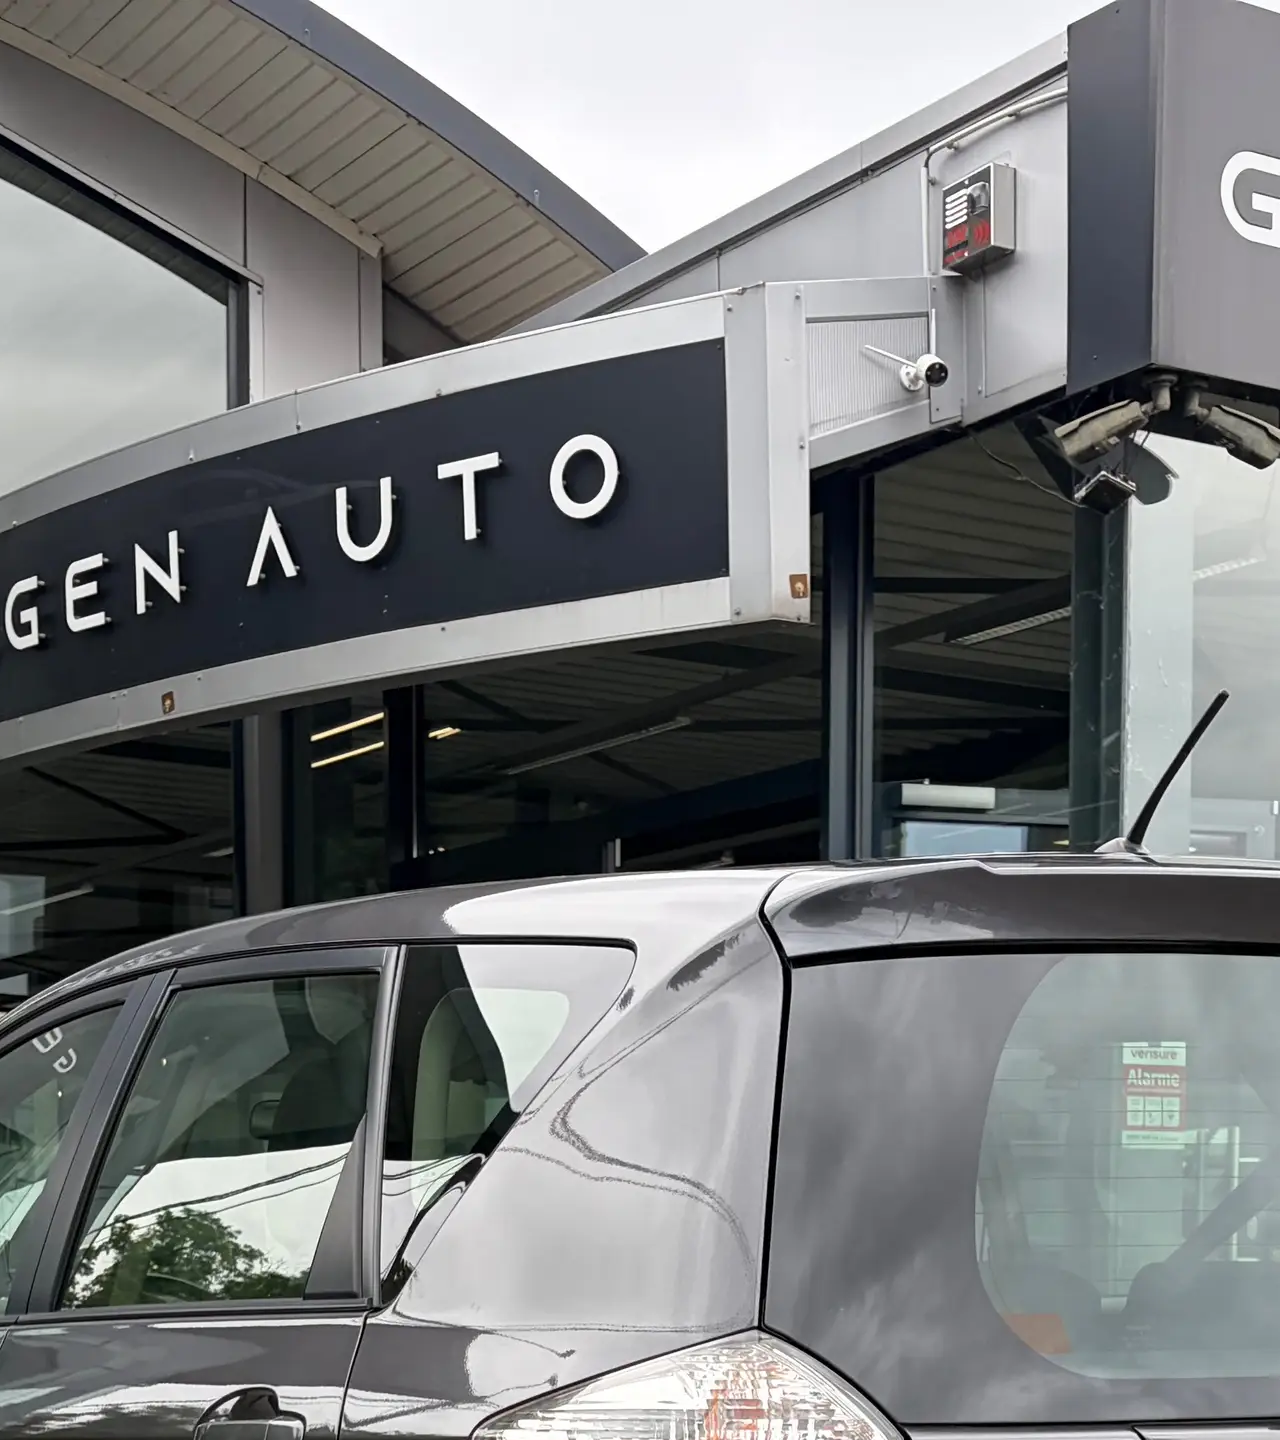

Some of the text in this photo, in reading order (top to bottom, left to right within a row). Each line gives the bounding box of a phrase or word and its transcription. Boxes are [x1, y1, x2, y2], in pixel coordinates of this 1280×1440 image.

[3, 433, 620, 651] GEN AUTO
[1127, 1067, 1181, 1087] Alarme
